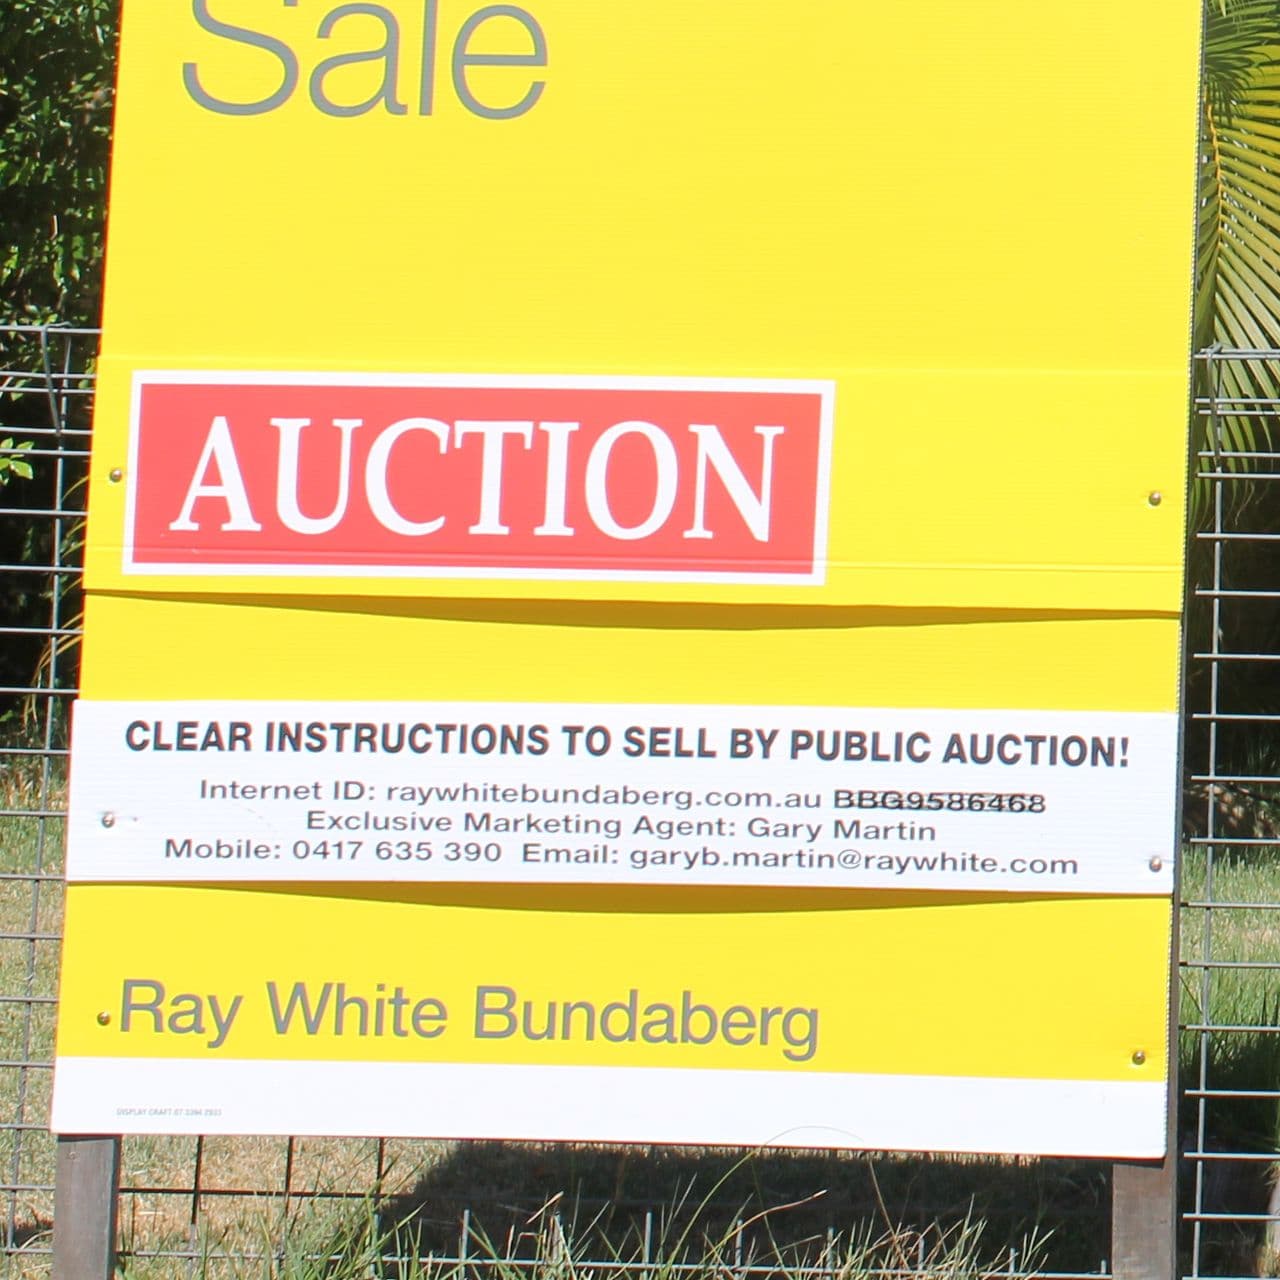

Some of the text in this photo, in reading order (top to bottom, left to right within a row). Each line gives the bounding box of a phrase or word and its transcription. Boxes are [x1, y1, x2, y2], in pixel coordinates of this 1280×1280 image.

[170, 416, 784, 542] AUCTION
[126, 720, 1128, 767] CLEAR INSTRUCTIONS TO SELL BY PUBLIC AUCTION!
[201, 780, 321, 799] Internet
[334, 781, 374, 800] ID:
[388, 783, 820, 809] raywhitebundaberg.com.au
[308, 811, 935, 843] Exclusive Marketing Agent: Gary Martin
[166, 839, 1077, 874] Mobile: 0417 635 390 Email: garyb.martin@raywhite.com
[120, 980, 817, 1061] Ray White Bundaberg
